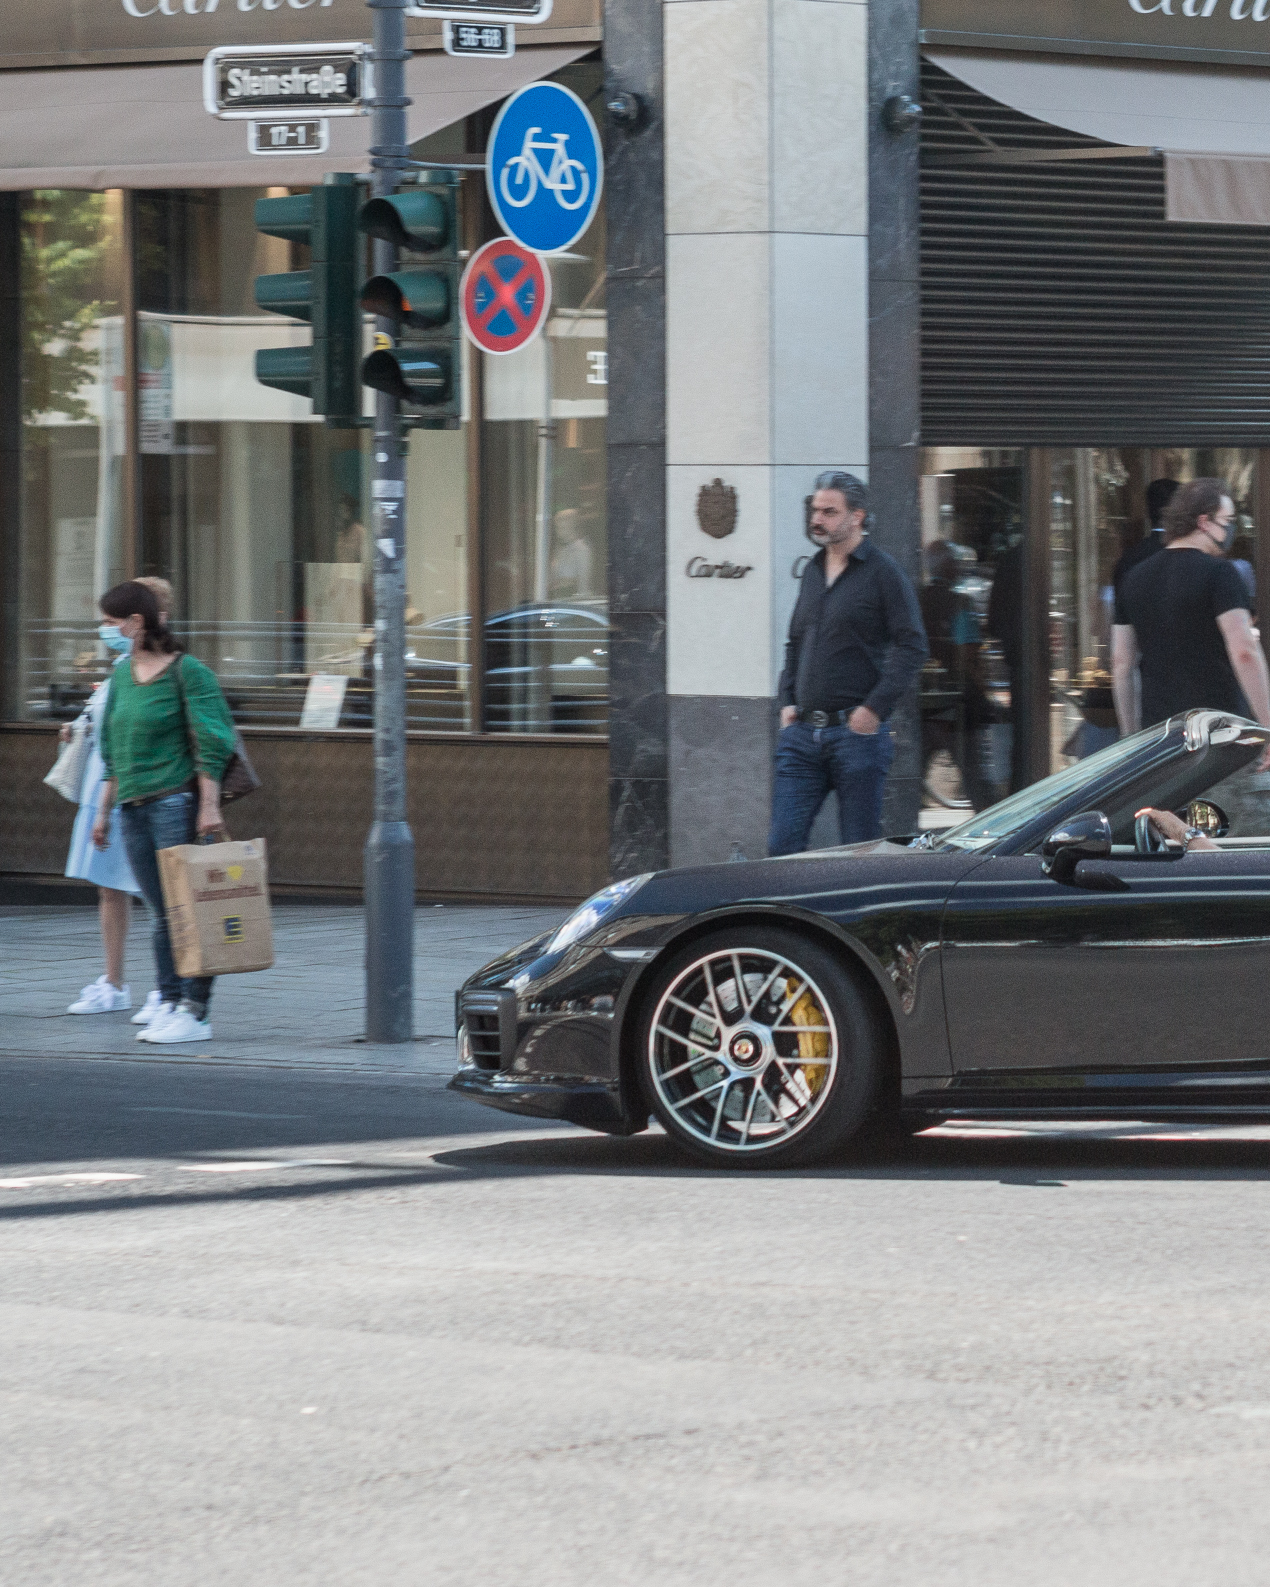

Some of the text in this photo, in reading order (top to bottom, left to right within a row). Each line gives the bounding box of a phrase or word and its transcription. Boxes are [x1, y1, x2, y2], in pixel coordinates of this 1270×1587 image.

[227, 65, 347, 98] Steinstraße
[269, 125, 306, 146] 17-1
[684, 555, 754, 580] Cartier
